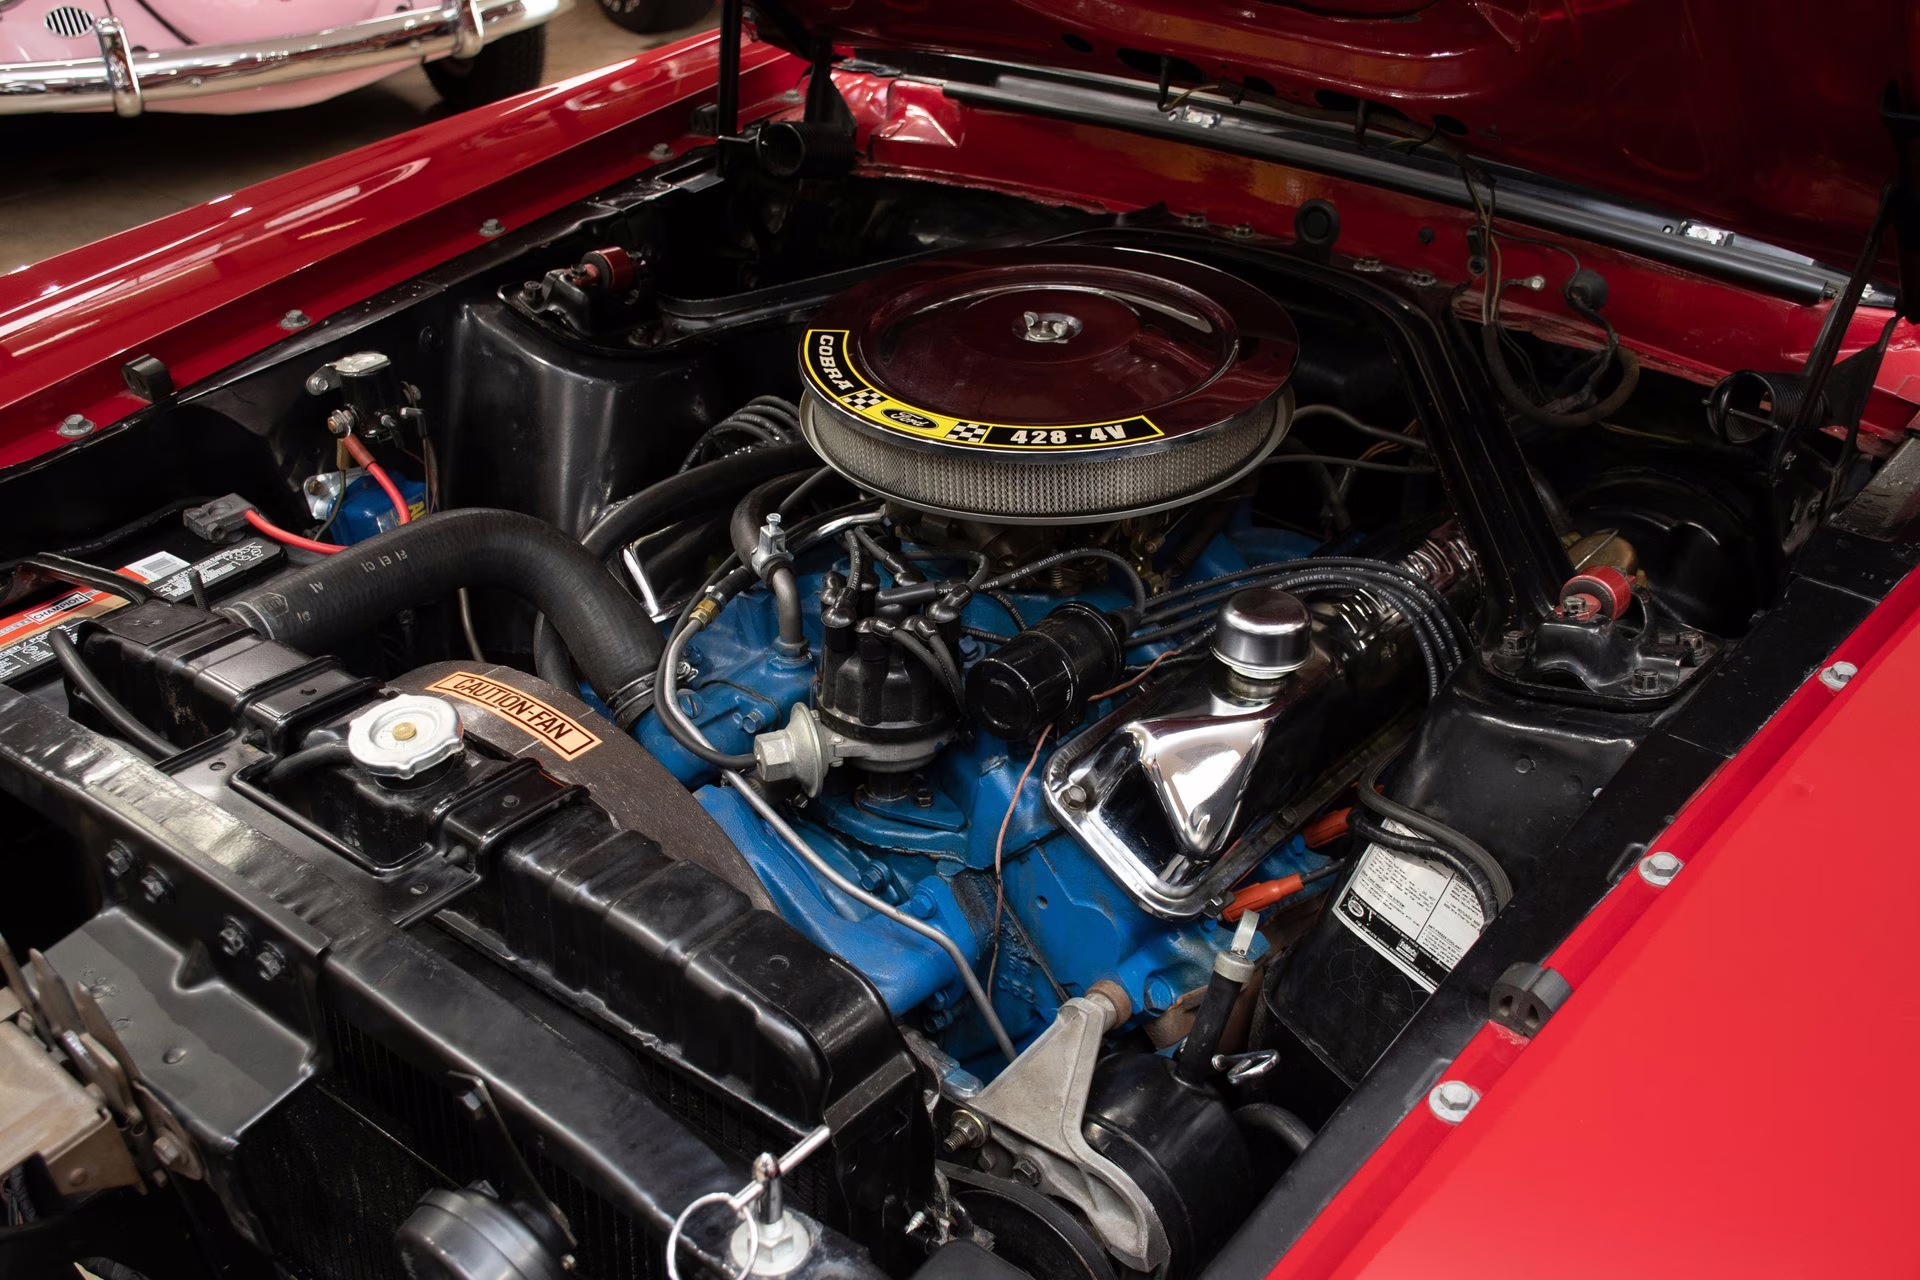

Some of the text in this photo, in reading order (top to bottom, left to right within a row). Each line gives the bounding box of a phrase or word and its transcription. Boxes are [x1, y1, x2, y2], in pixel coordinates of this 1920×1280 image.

[819, 334, 855, 391] COBRA
[890, 411, 929, 427] Ford
[1010, 429, 1067, 445] 428
[1089, 424, 1127, 442] 4V
[1038, 552, 1065, 567] AUTOLITE
[979, 580, 999, 590] RADIO
[34, 595, 84, 620] CHAMPION
[1404, 597, 1422, 612] RADIO
[1423, 641, 1433, 662] RADIO
[453, 678, 574, 740] CAUTION-FAN
